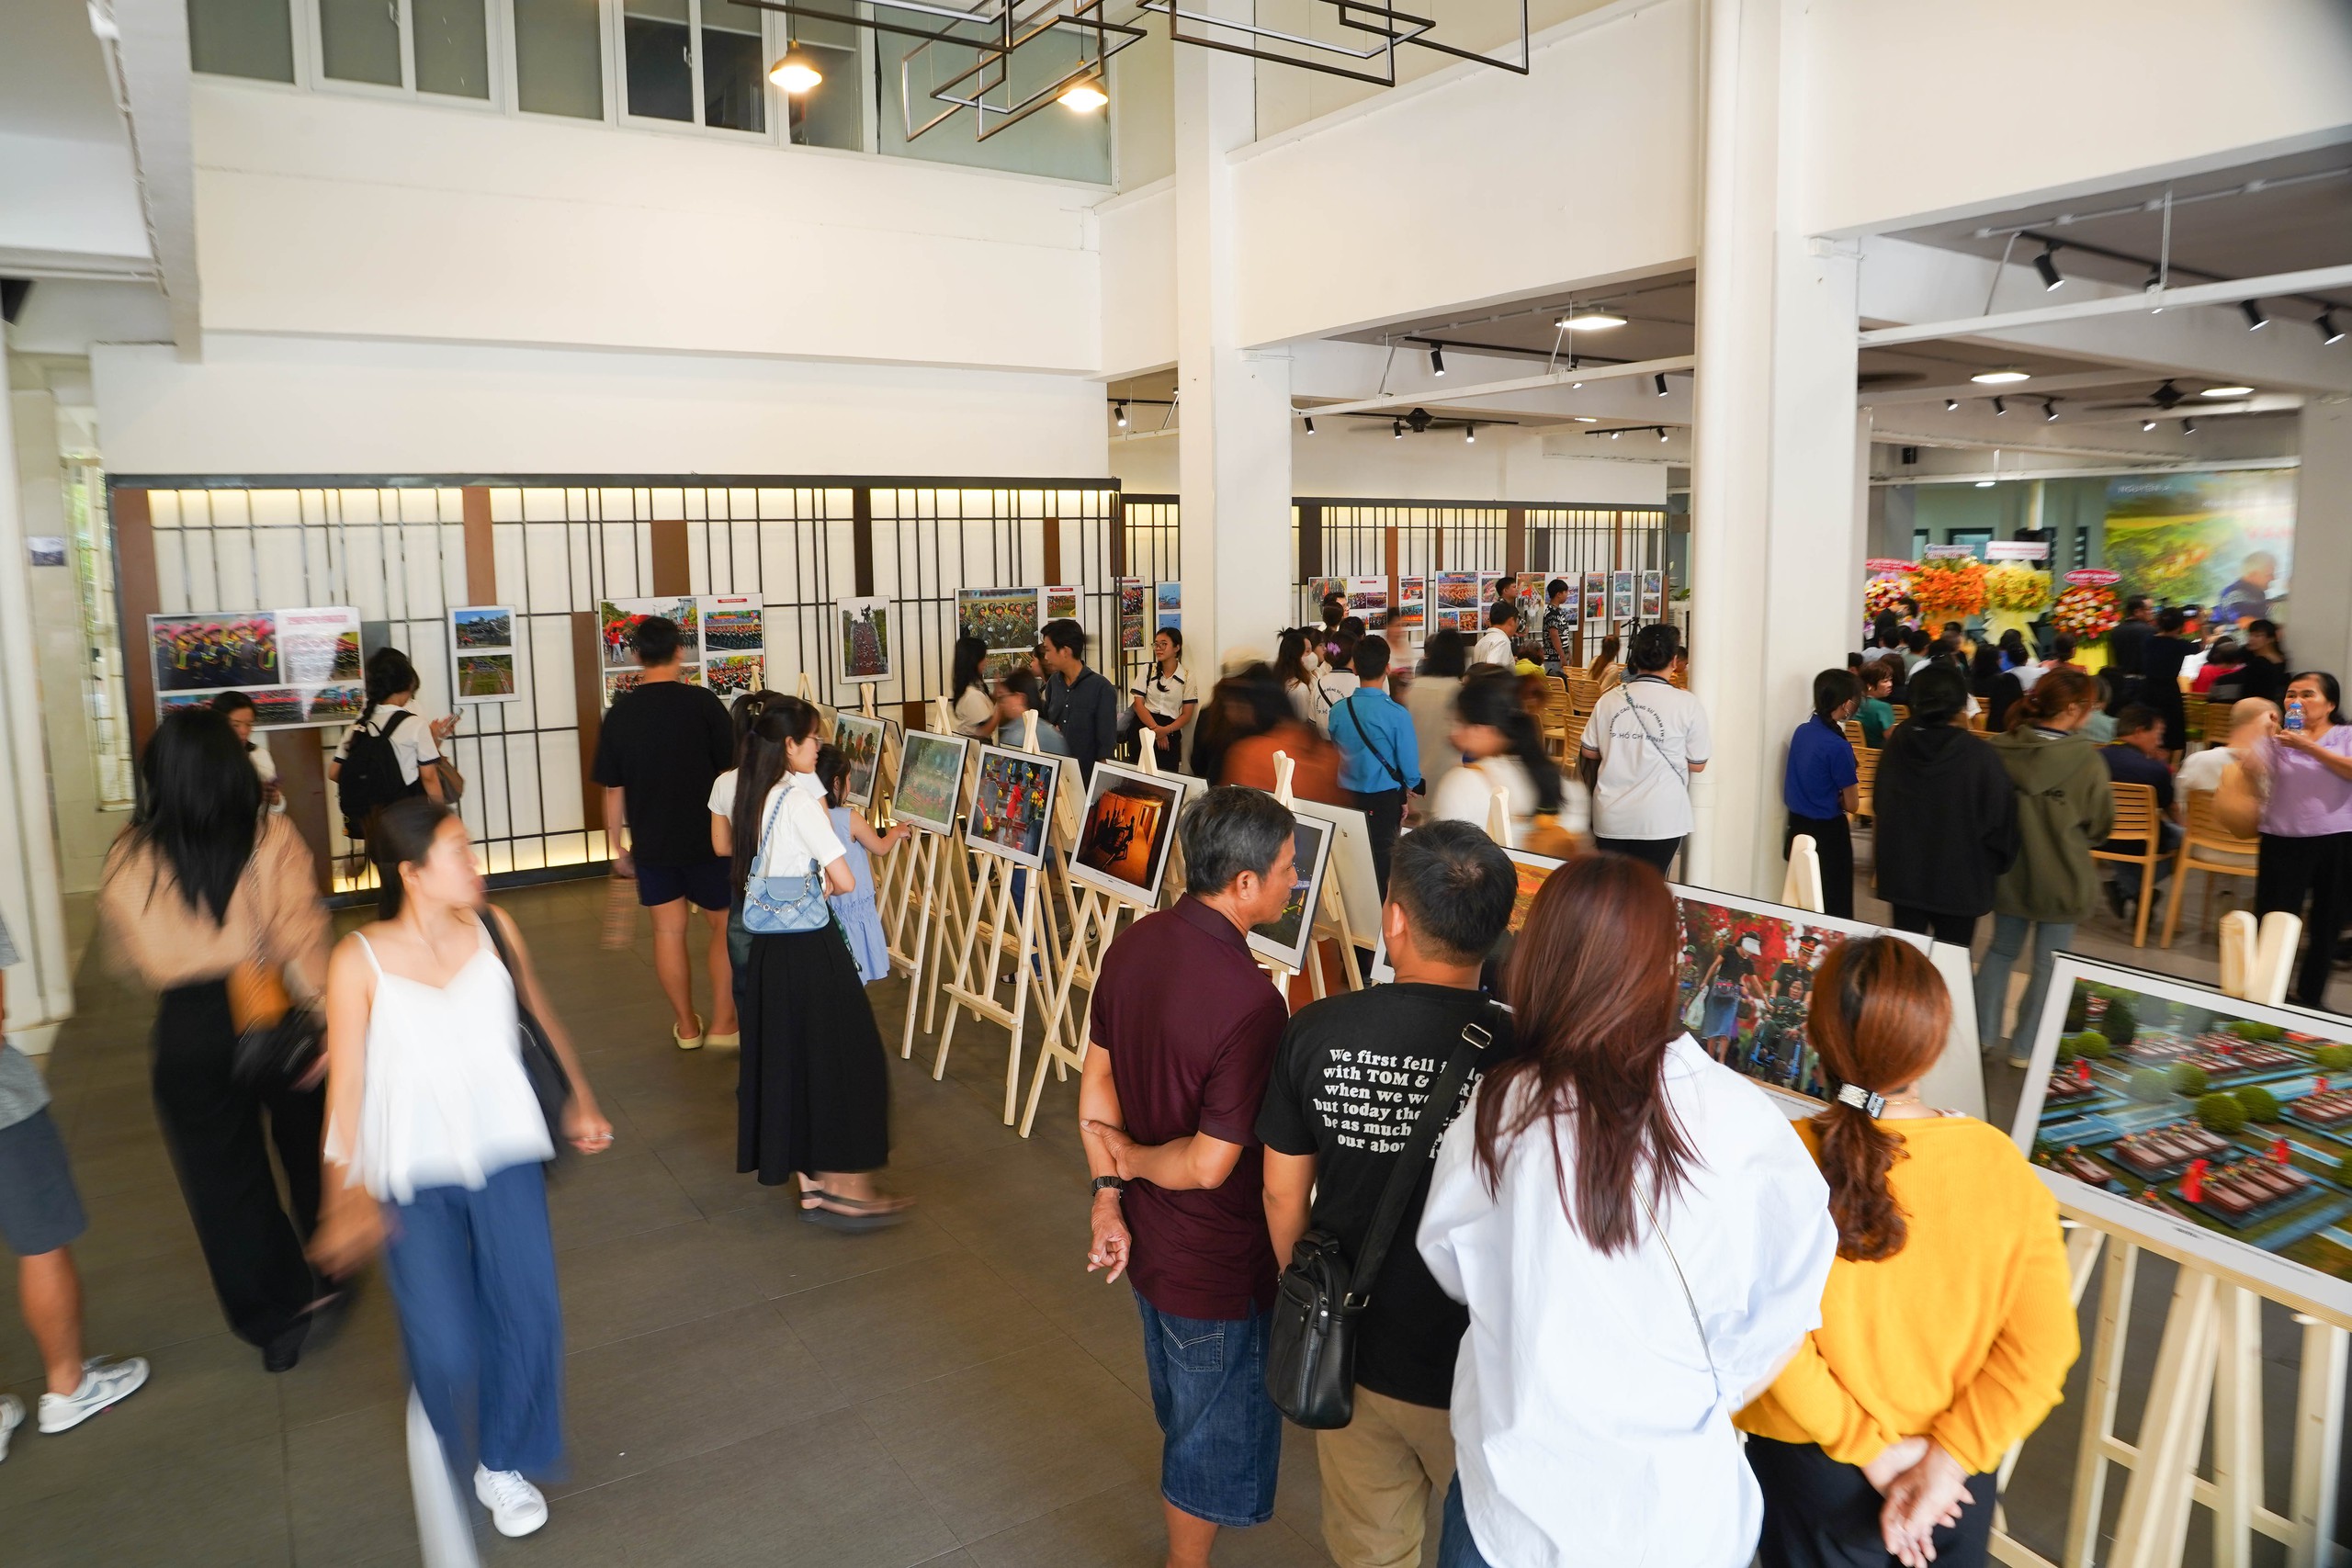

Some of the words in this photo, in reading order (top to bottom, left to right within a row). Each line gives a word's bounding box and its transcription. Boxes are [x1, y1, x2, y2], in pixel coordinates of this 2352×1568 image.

[1329, 1049, 1352, 1062] We
[1356, 1050, 1397, 1067] first
[1401, 1055, 1434, 1073] fell
[1323, 1065, 1361, 1080] with
[1366, 1068, 1409, 1087] TOM
[1414, 1075, 1430, 1089] &
[1324, 1082, 1371, 1100] when
[1376, 1090, 1403, 1103] we
[1312, 1098, 1339, 1113] but
[1342, 1102, 1392, 1122] today
[1322, 1114, 1339, 1129] be
[1340, 1120, 1360, 1132] as
[1363, 1122, 1412, 1136] much
[1337, 1134, 1366, 1149] our
